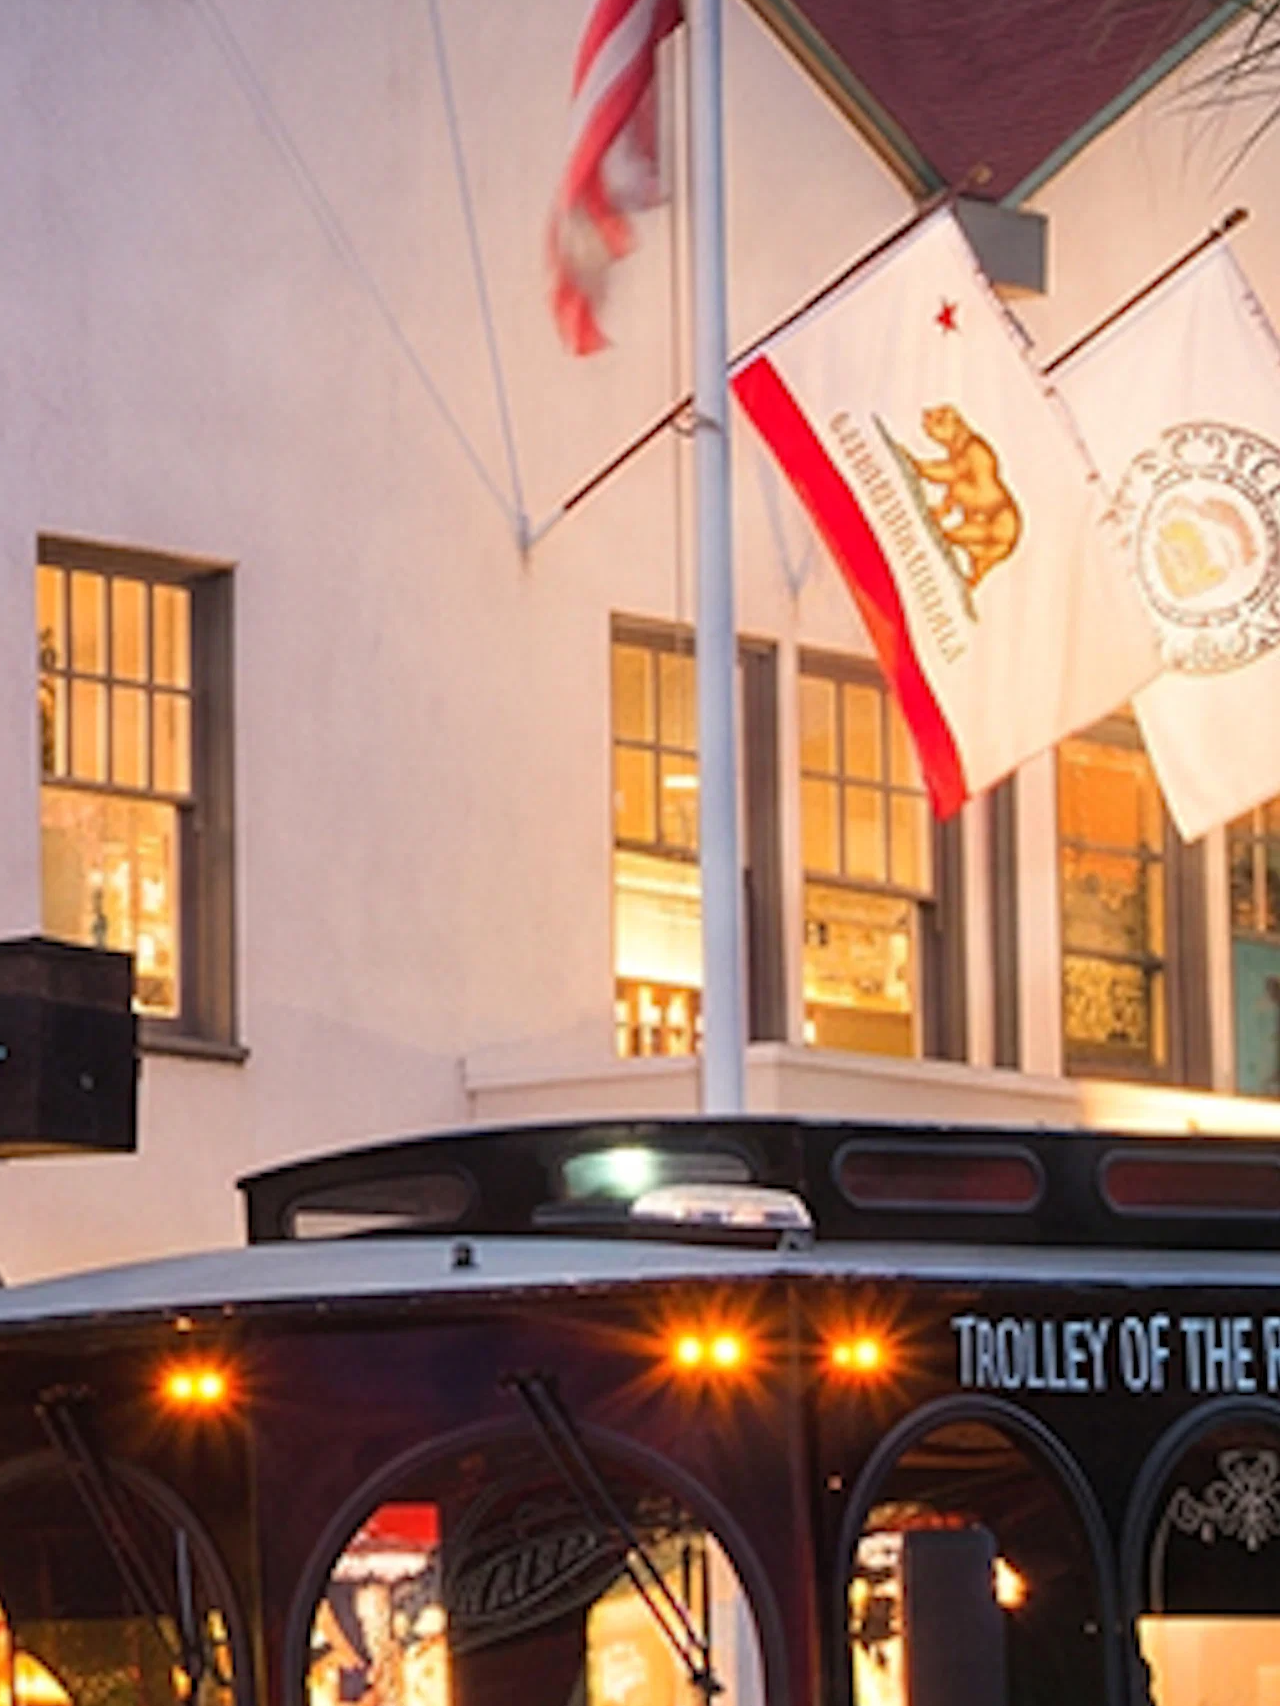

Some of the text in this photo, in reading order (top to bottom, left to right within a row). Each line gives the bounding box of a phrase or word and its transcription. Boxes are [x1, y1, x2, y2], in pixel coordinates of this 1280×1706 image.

[950, 1313, 1112, 1391] TROLLEY
[1119, 1314, 1171, 1393] OF
[1180, 1315, 1258, 1393] THE
